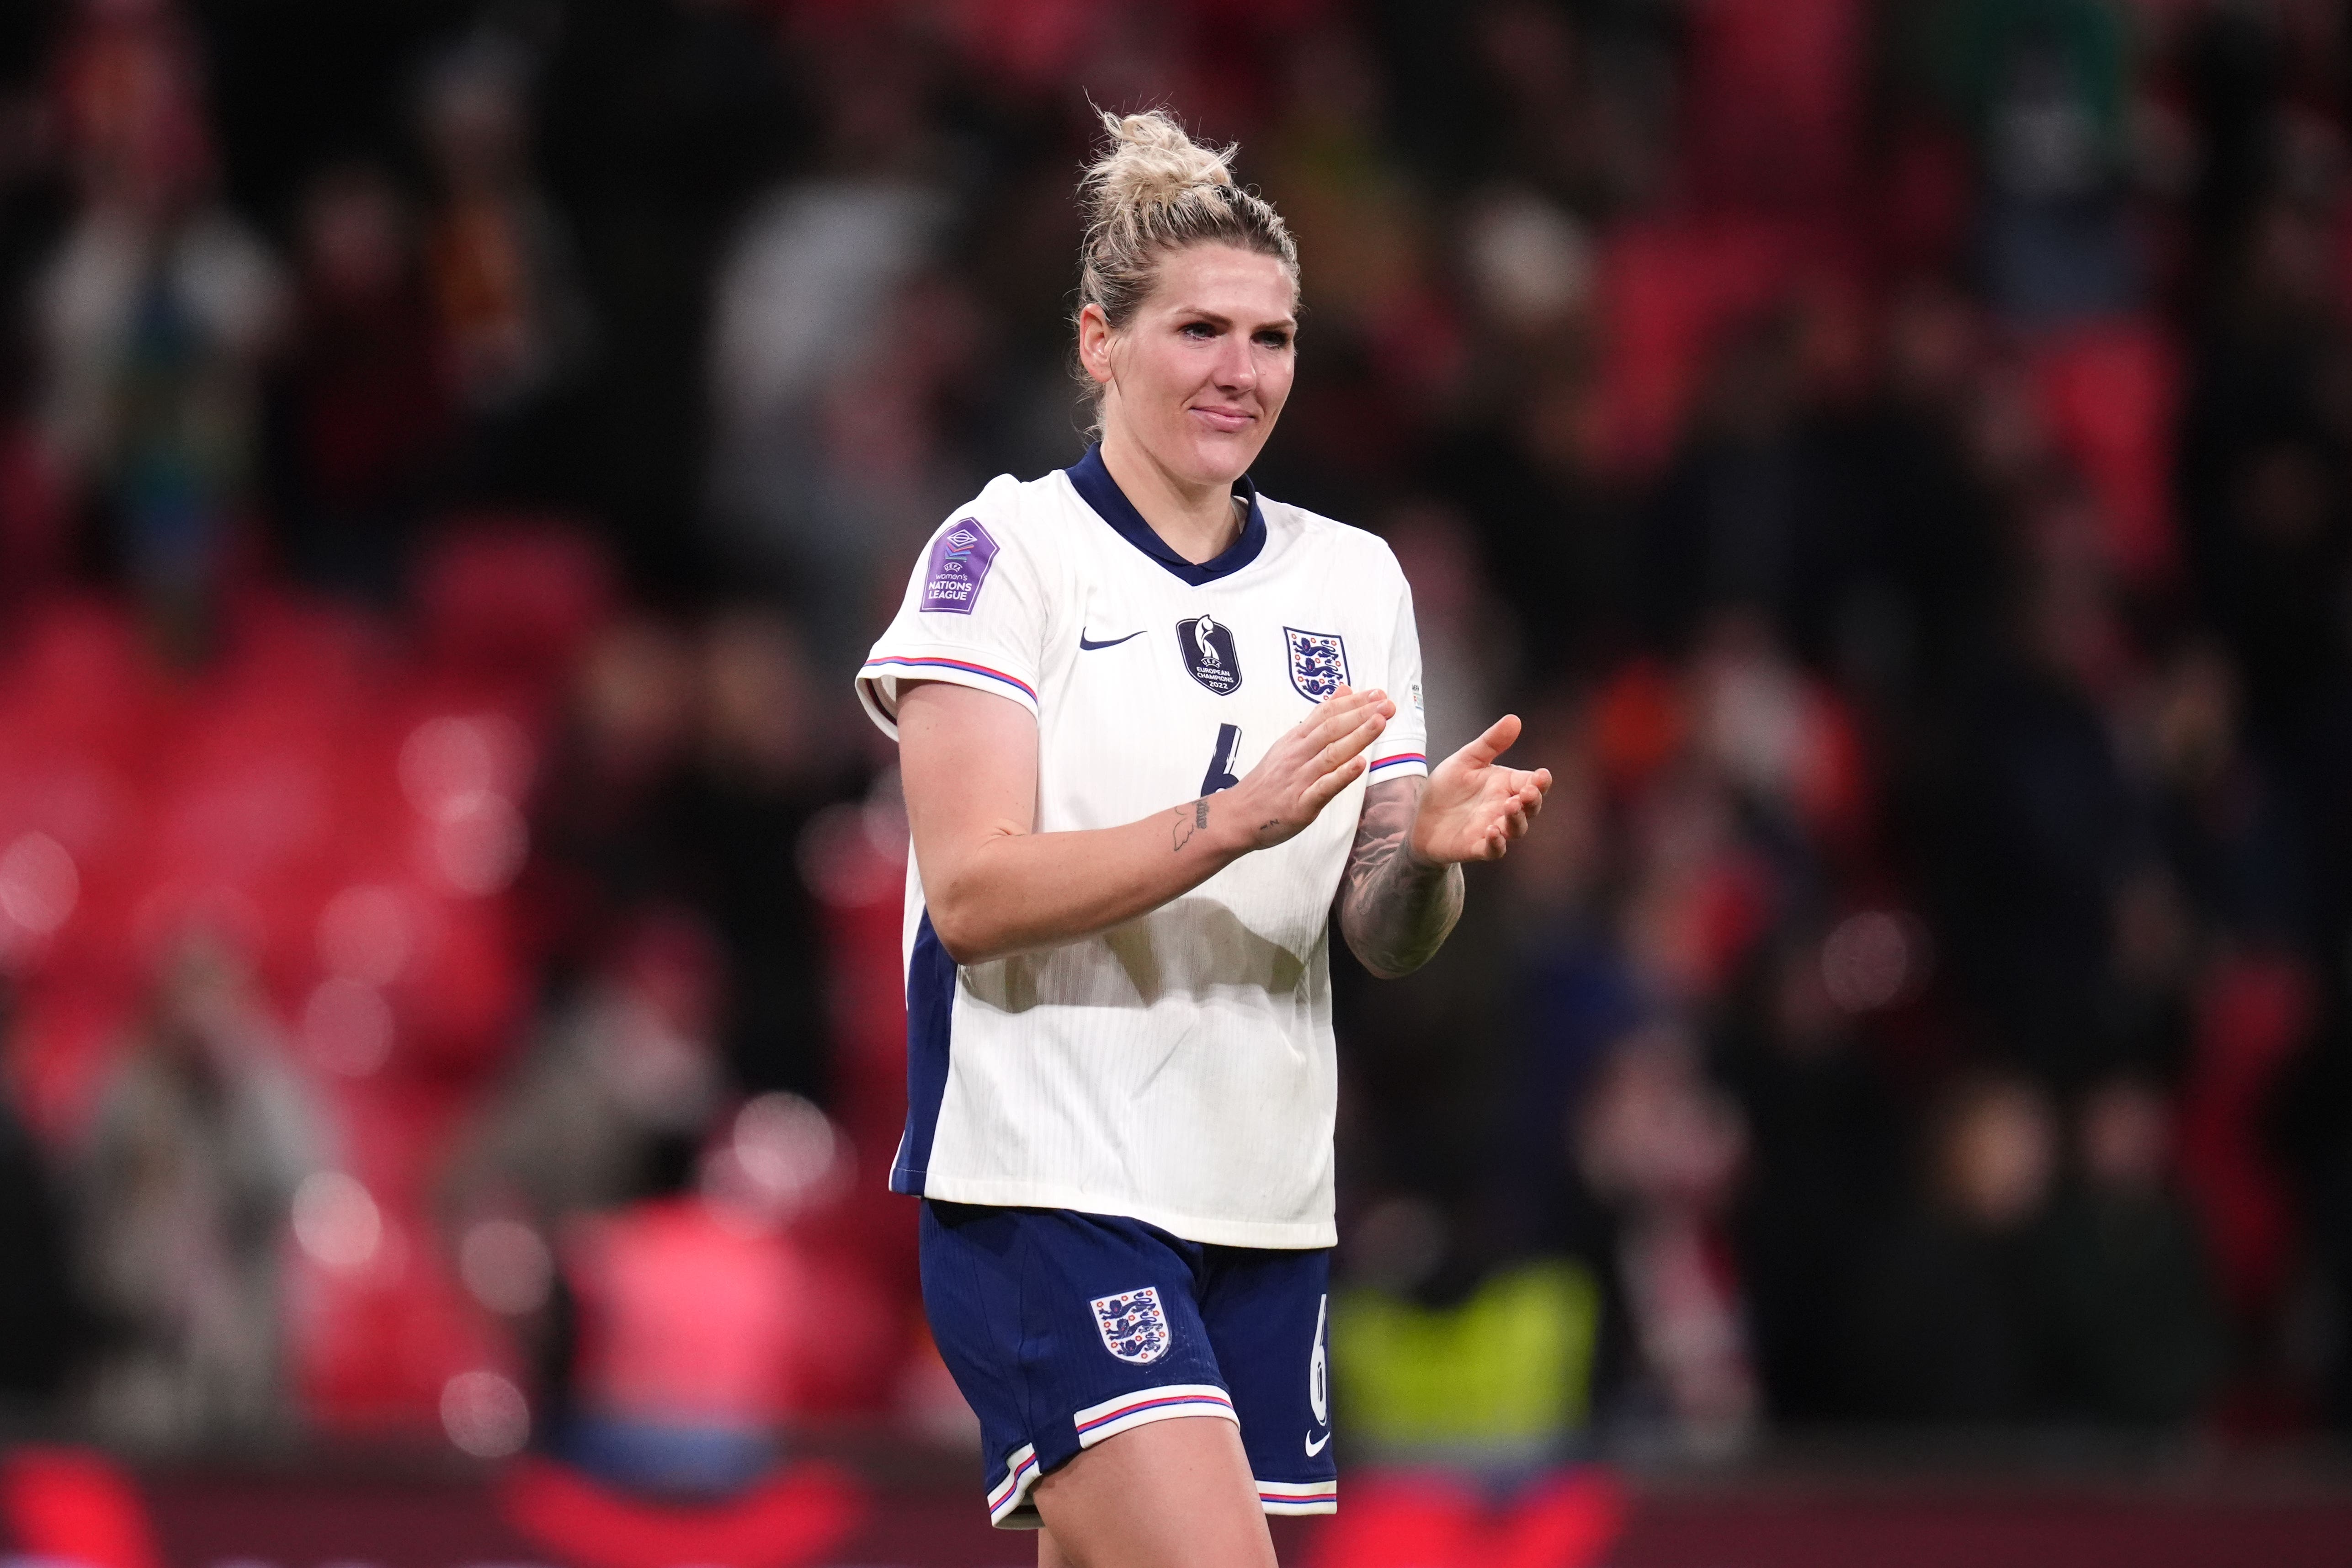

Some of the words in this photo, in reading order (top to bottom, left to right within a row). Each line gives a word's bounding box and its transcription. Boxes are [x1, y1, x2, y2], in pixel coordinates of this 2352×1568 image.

[928, 581, 972, 592] NATIONS
[928, 590, 967, 601] LEAGUE
[1202, 659, 1220, 667] UEFA
[1196, 666, 1230, 676] EUROPEAN
[1197, 672, 1234, 683] CHAMPIONS
[1208, 681, 1229, 689] 2022
[1310, 1294, 1326, 1426] 6
